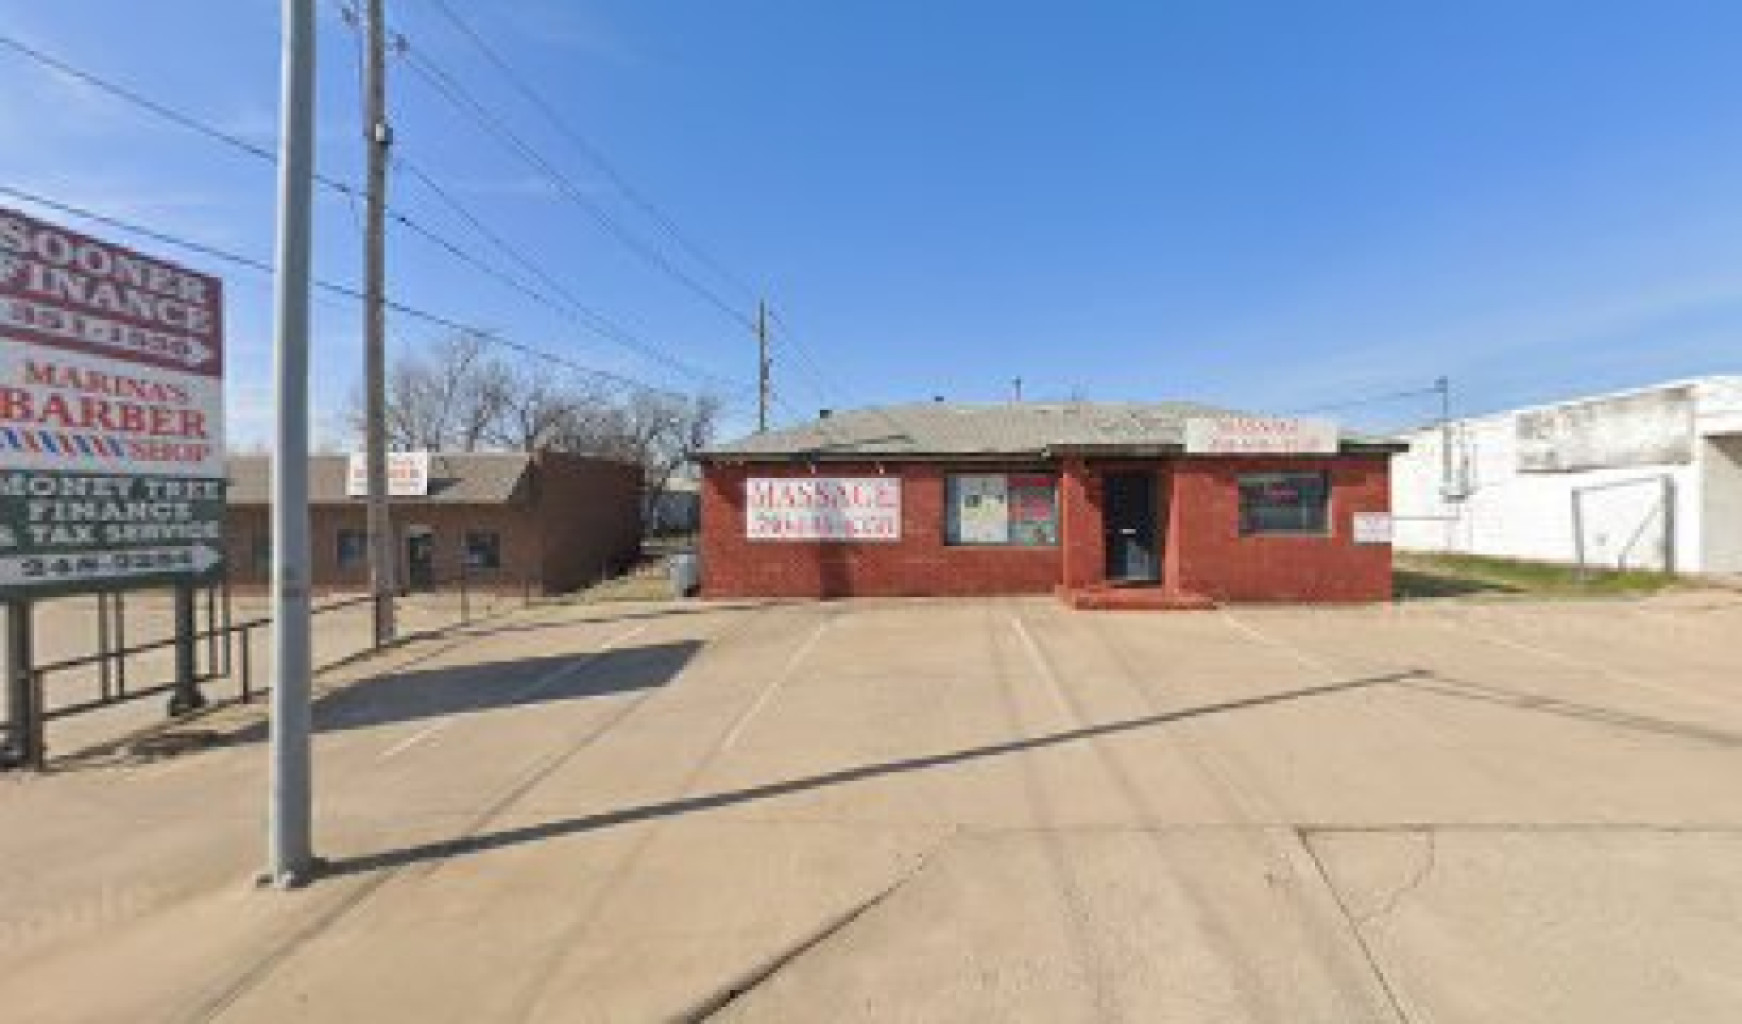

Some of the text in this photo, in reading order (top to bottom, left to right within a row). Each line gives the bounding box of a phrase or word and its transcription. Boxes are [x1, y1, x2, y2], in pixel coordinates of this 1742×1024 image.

[0, 217, 206, 303] SOONER
[0, 387, 208, 438] BARBER
[130, 441, 210, 462] SHOP
[752, 480, 897, 508] MASSAGE
[28, 501, 192, 522] FINANCE
[29, 523, 96, 545] TAX
[105, 519, 219, 542] SERVICE
